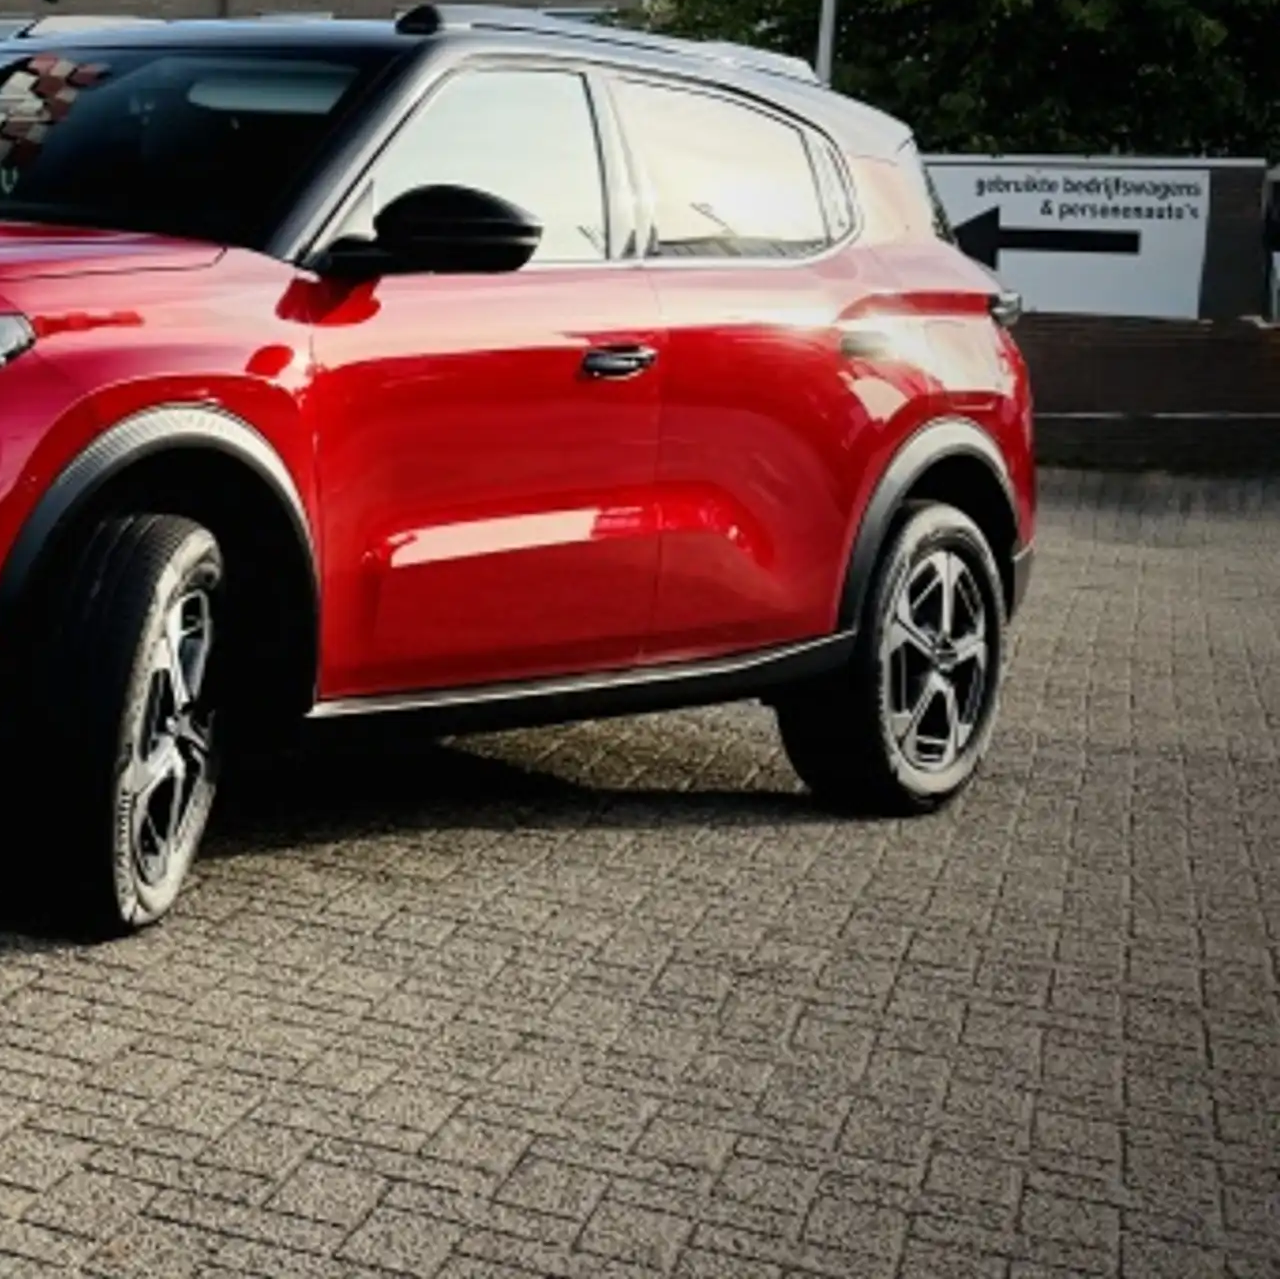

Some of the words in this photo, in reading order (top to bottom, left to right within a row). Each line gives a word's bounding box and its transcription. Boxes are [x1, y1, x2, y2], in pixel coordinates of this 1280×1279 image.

[975, 175, 1060, 197] gebruikte
[1062, 176, 1202, 201] bedrijfswagens
[1040, 199, 1054, 217] &
[1058, 202, 1200, 221] personenauto's
